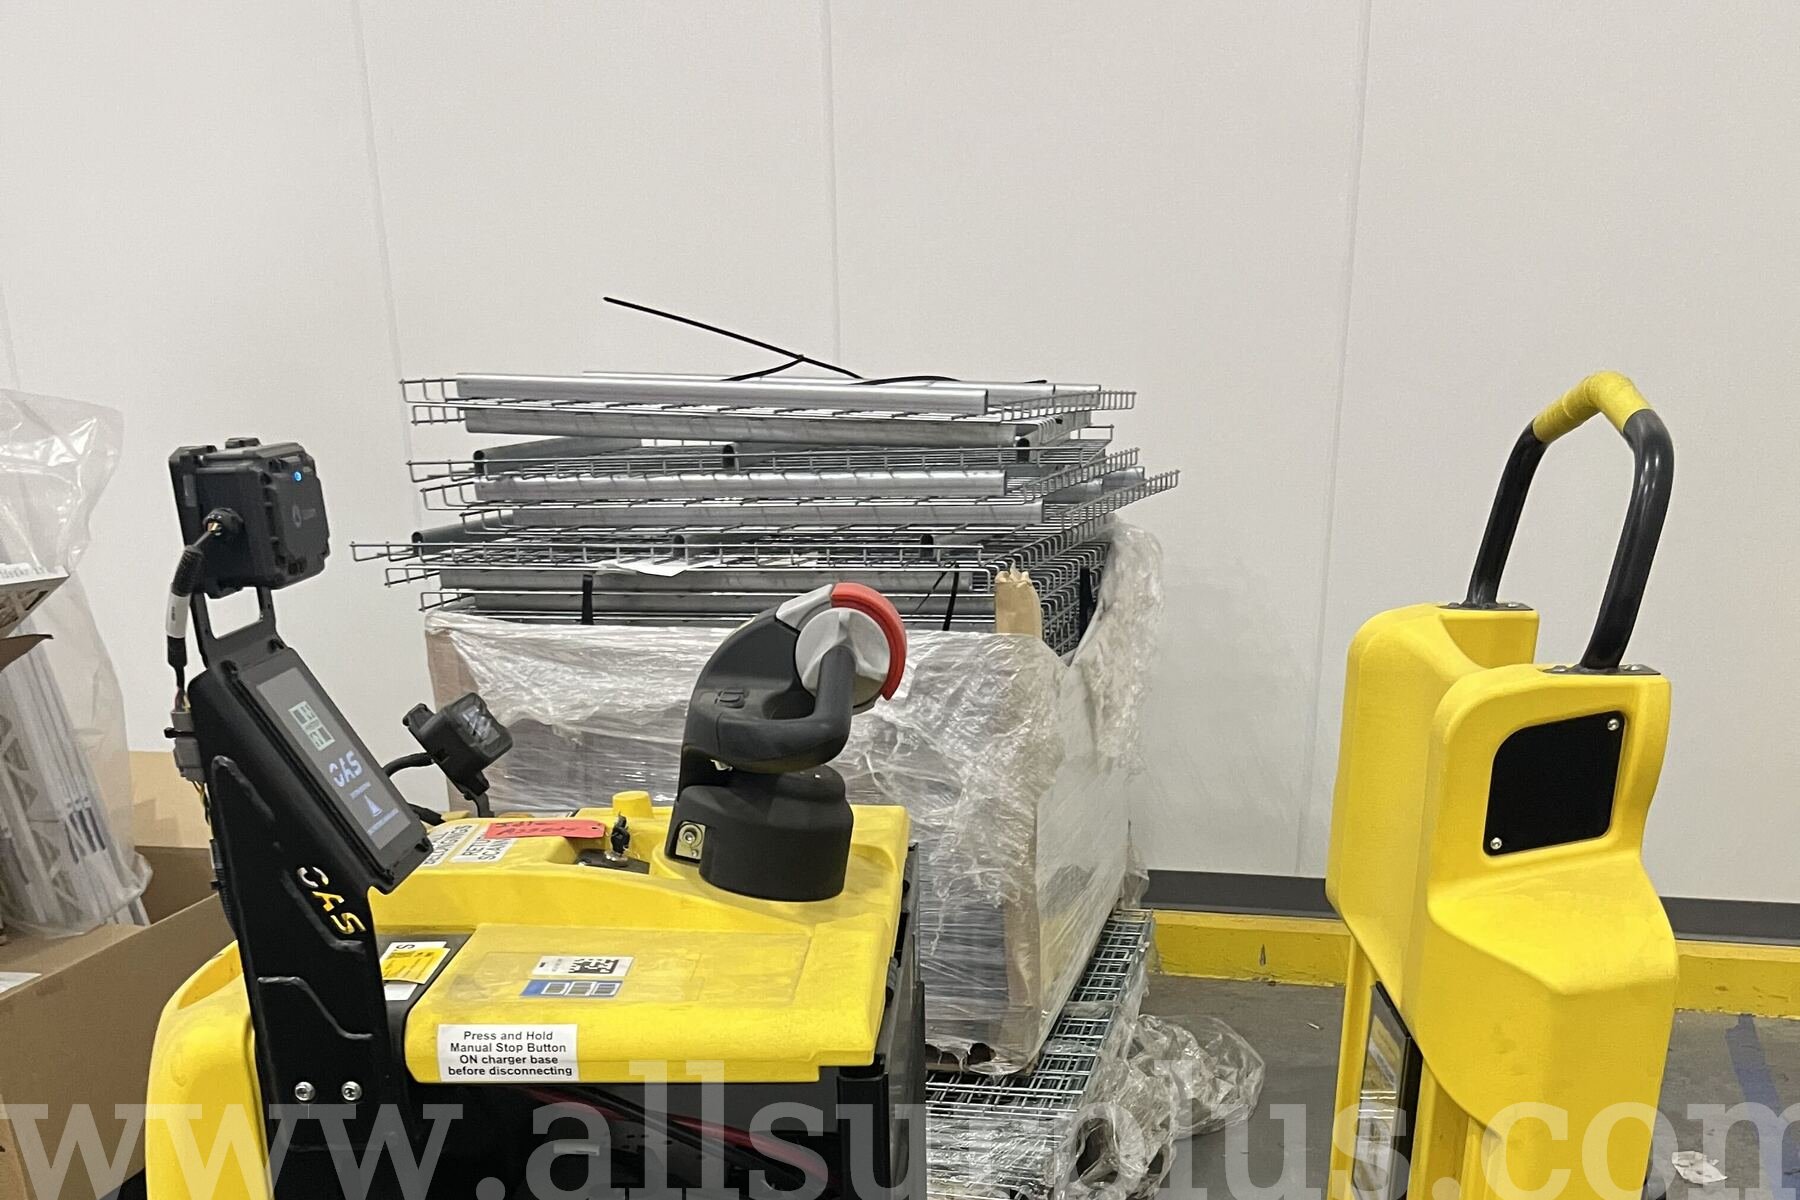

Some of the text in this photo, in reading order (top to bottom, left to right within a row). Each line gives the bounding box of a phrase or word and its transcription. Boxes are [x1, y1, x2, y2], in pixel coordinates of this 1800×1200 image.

[463, 1031, 553, 1041] Press and Hold
[450, 1042, 567, 1053] Manual Stop Button
[459, 1054, 559, 1065] ON charger base
[448, 1066, 573, 1077] before disconnecting
